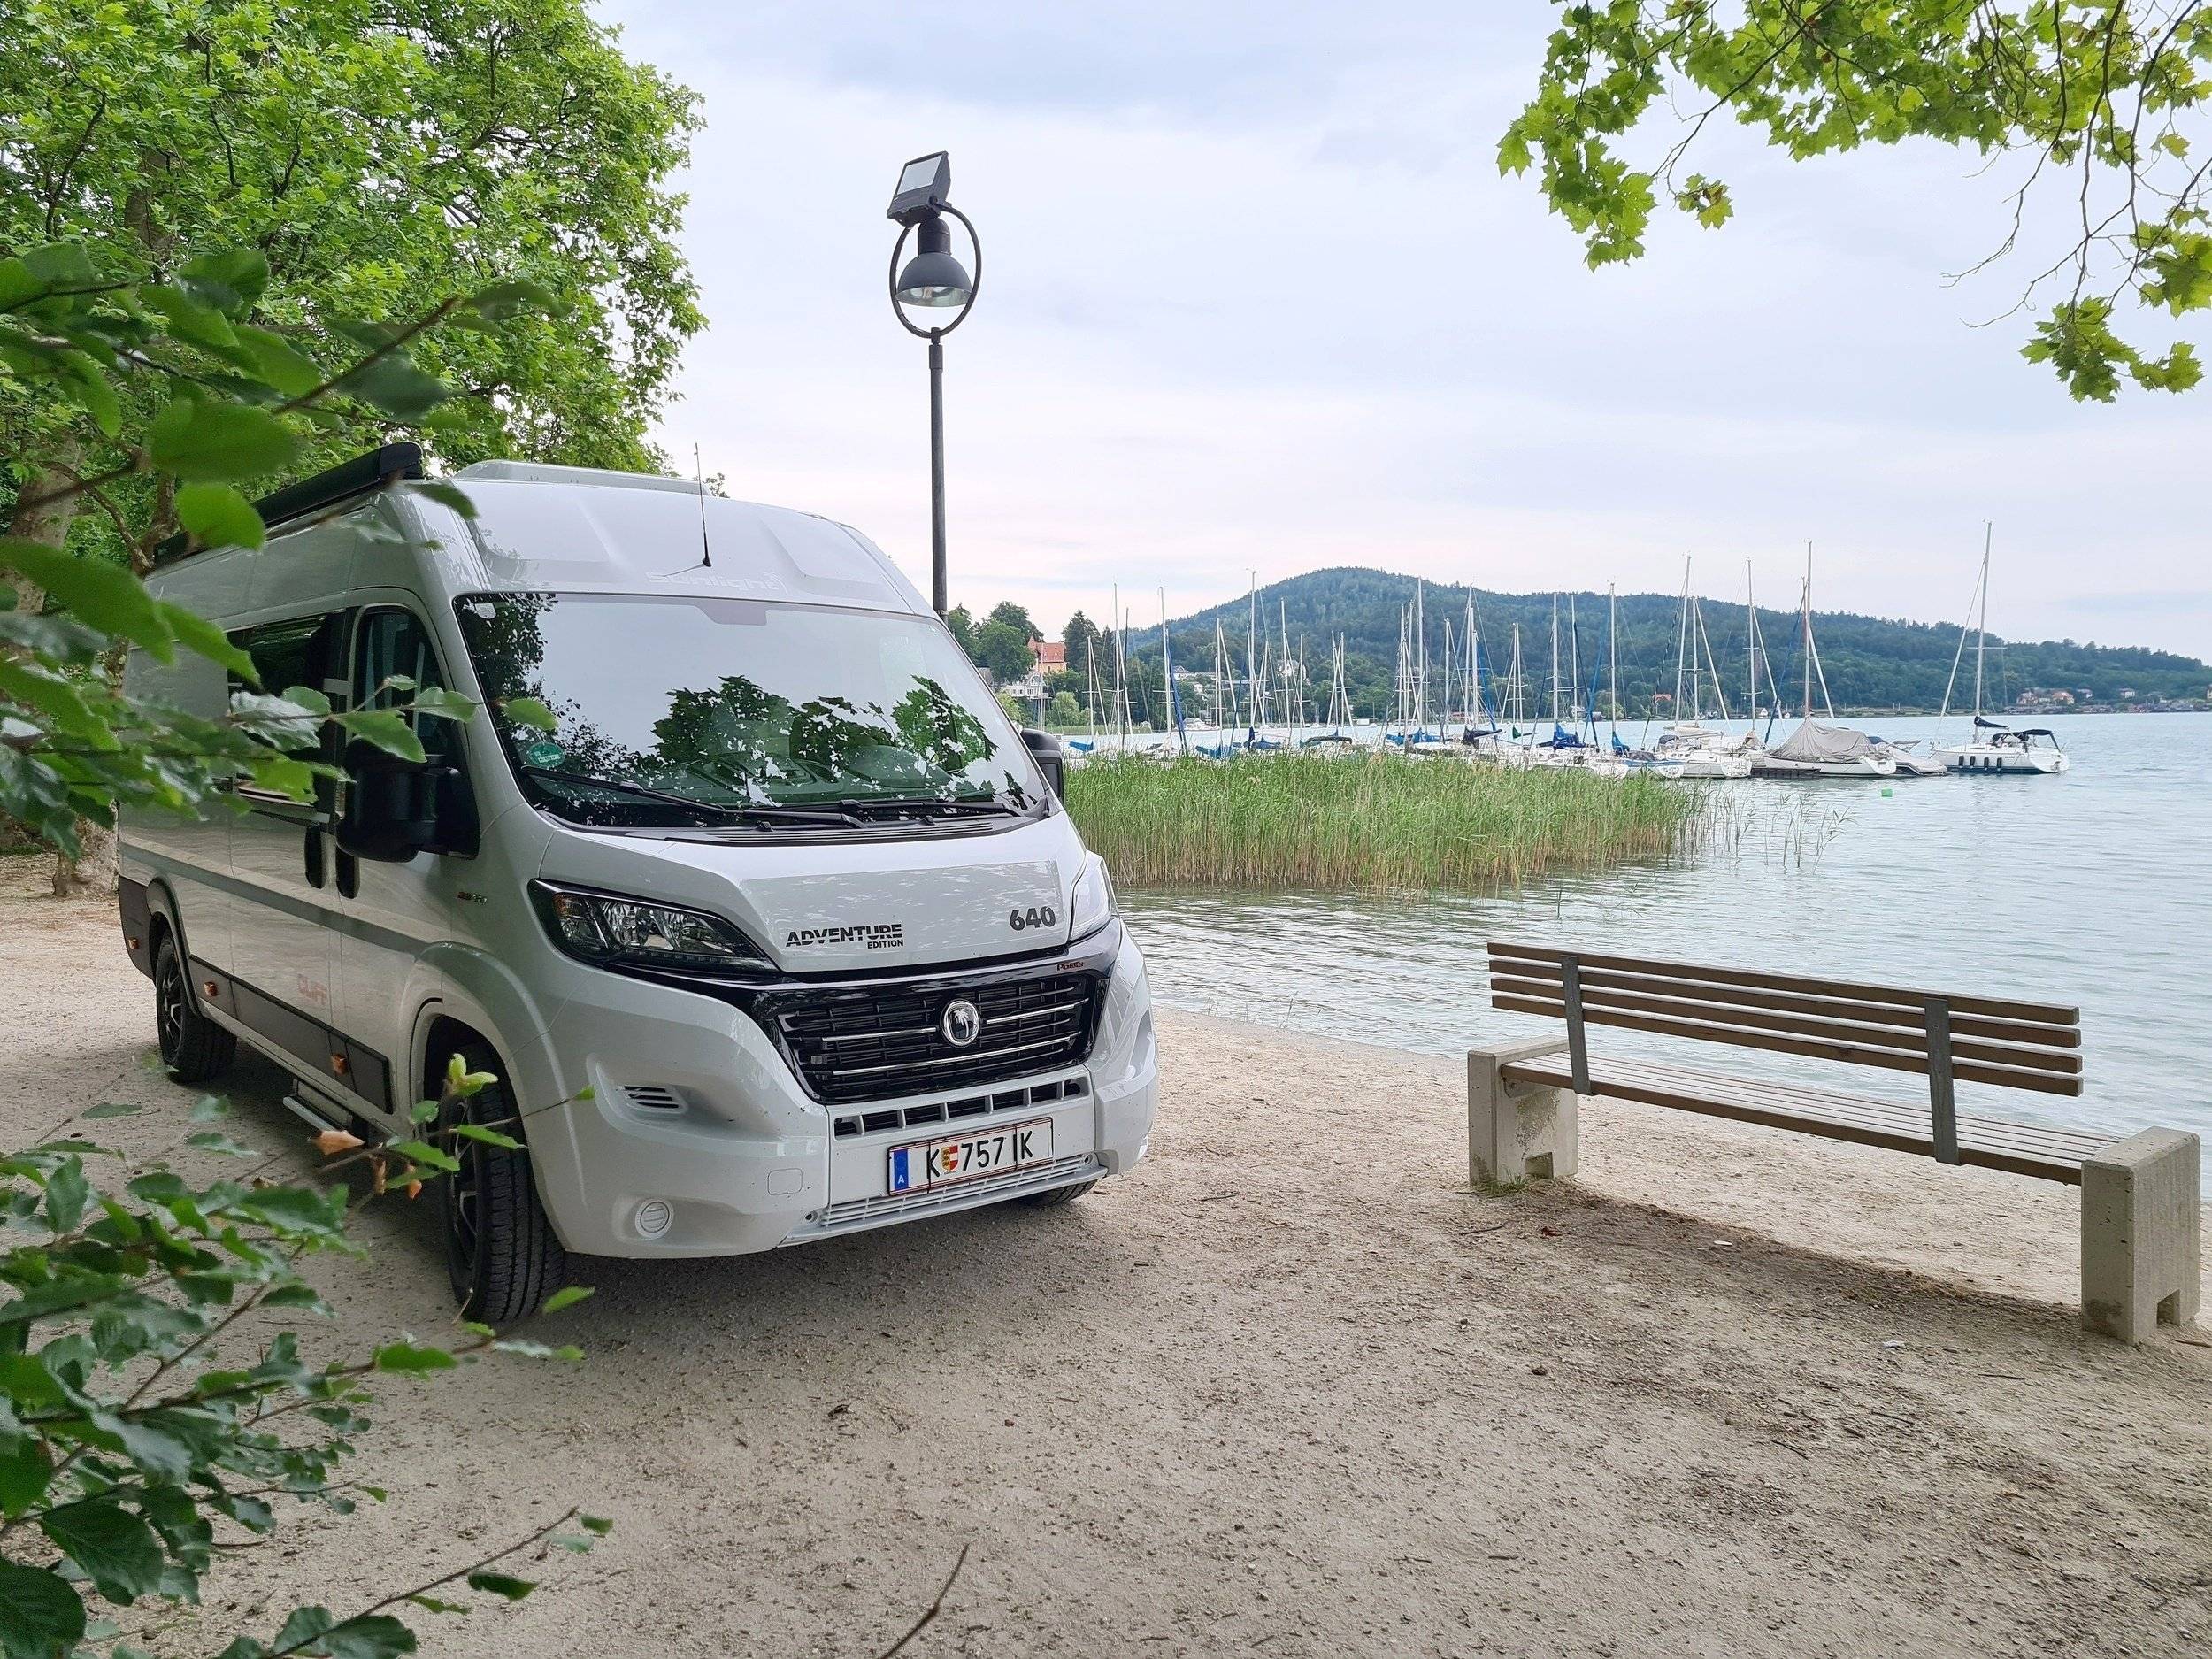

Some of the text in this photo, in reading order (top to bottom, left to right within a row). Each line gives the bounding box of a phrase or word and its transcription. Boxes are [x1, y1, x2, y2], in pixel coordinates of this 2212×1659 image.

[1010, 906, 1056, 931] 640
[786, 924, 902, 947] ADVENTURE
[868, 939, 903, 949] EDITION
[897, 1174, 904, 1184] A
[926, 1148, 940, 1178] K
[961, 1136, 1005, 1171] 757
